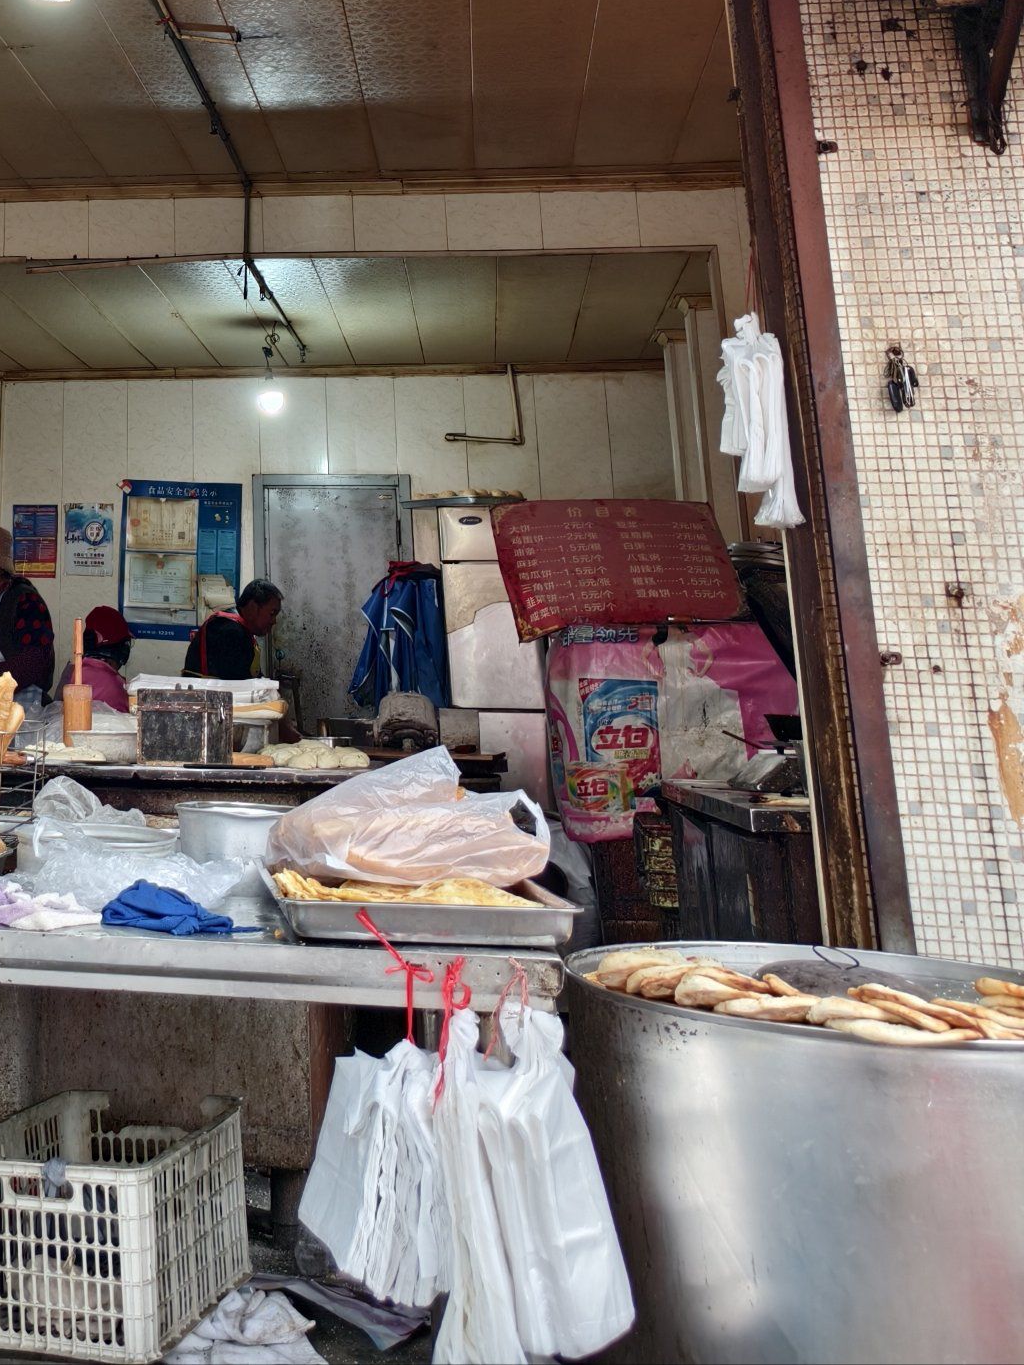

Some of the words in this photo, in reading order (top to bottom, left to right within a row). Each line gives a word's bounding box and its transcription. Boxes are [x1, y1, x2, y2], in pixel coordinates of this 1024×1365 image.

[566, 506, 637, 519] 价目表
[509, 523, 530, 533] 大饼
[521, 581, 555, 593] 三角饼
[595, 724, 650, 750] 立白
[576, 779, 609, 797] 立白
